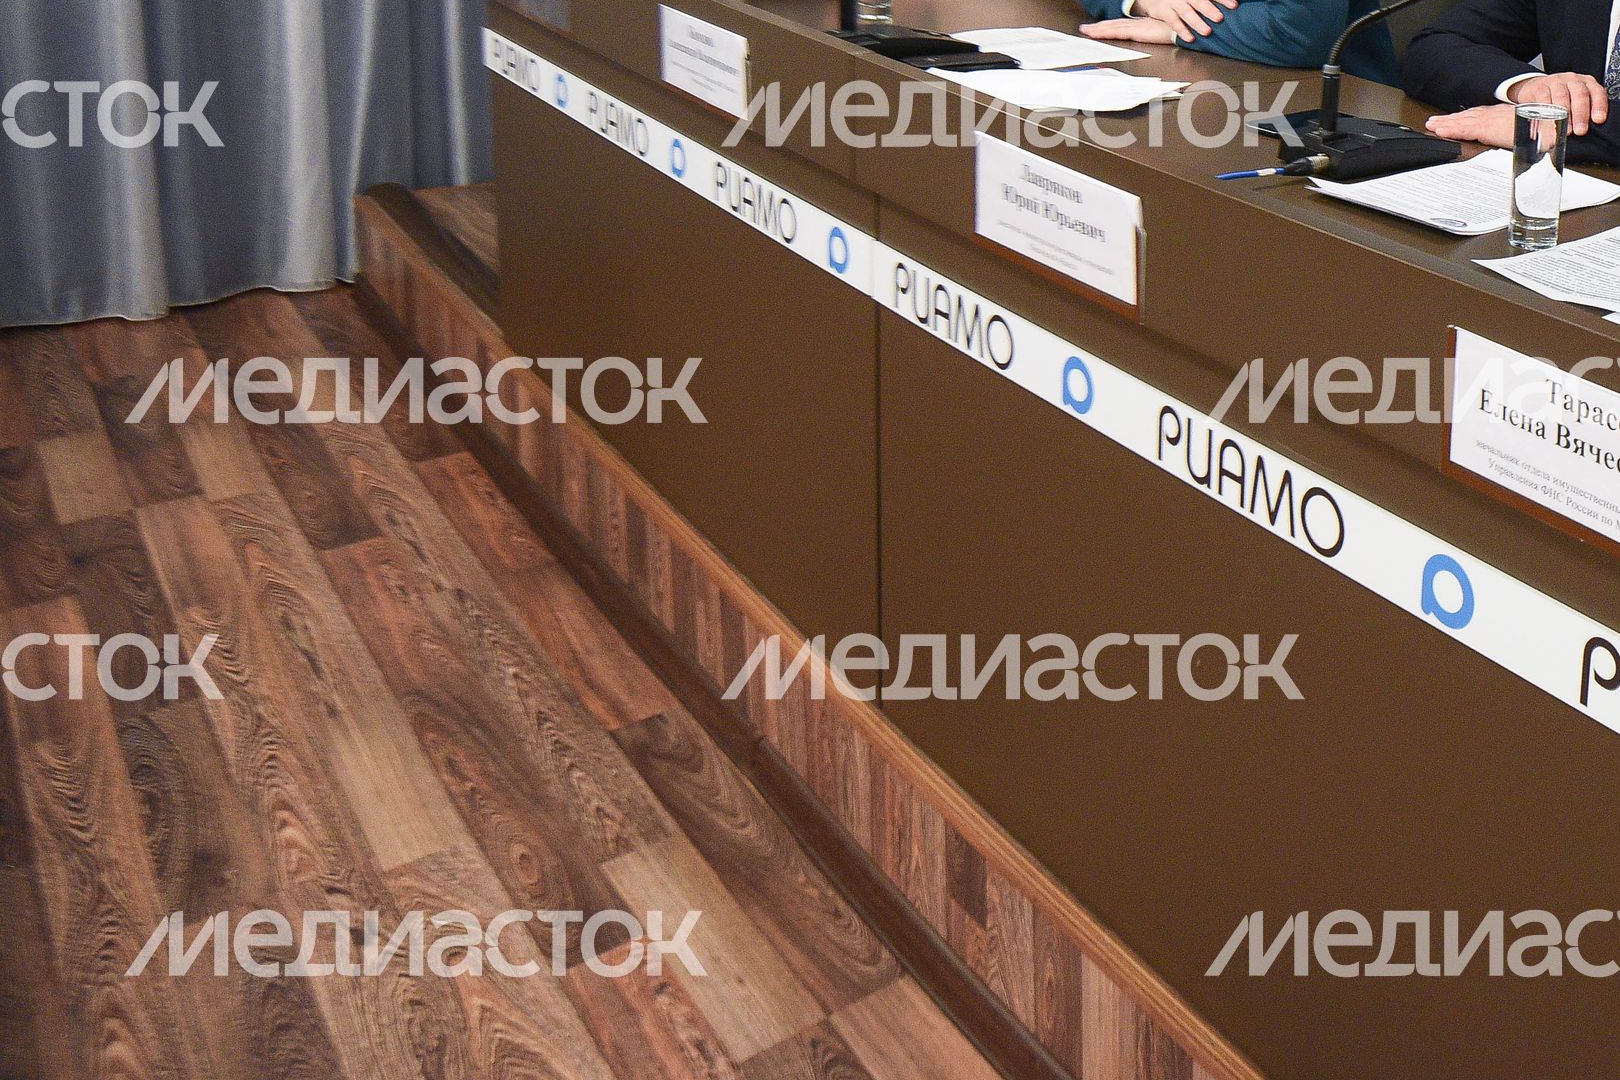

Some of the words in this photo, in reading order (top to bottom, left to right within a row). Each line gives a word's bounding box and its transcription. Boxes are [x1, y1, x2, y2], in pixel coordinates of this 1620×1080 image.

[1479, 387, 1547, 440] Елена
[1158, 405, 1345, 558] РИАМО
[1566, 495, 1600, 521] России
[1601, 514, 1614, 528] по
